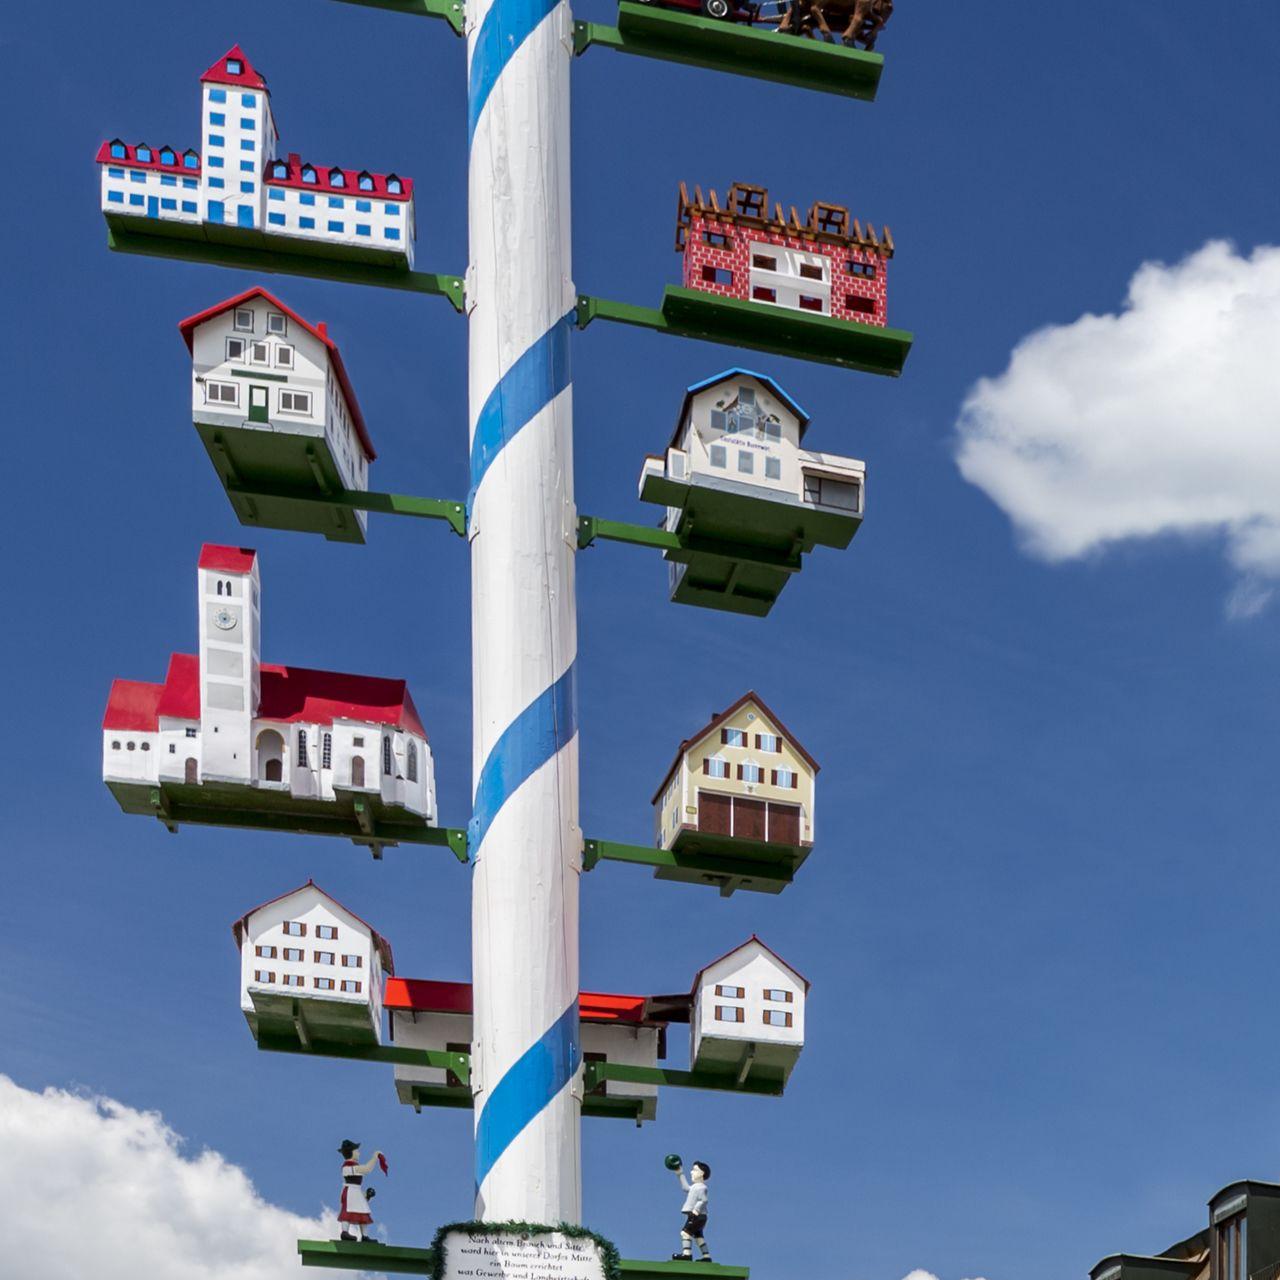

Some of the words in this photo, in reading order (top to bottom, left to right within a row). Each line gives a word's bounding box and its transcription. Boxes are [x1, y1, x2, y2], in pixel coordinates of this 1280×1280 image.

[491, 1237, 514, 1246] altem
[547, 1242, 563, 1250] und
[483, 1247, 498, 1256] hier
[571, 1254, 593, 1262] Mitte
[504, 1260, 528, 1269] Baum
[530, 1263, 563, 1271] errichtet
[475, 1268, 510, 1278] Gewerbe
[512, 1272, 529, 1280] und
